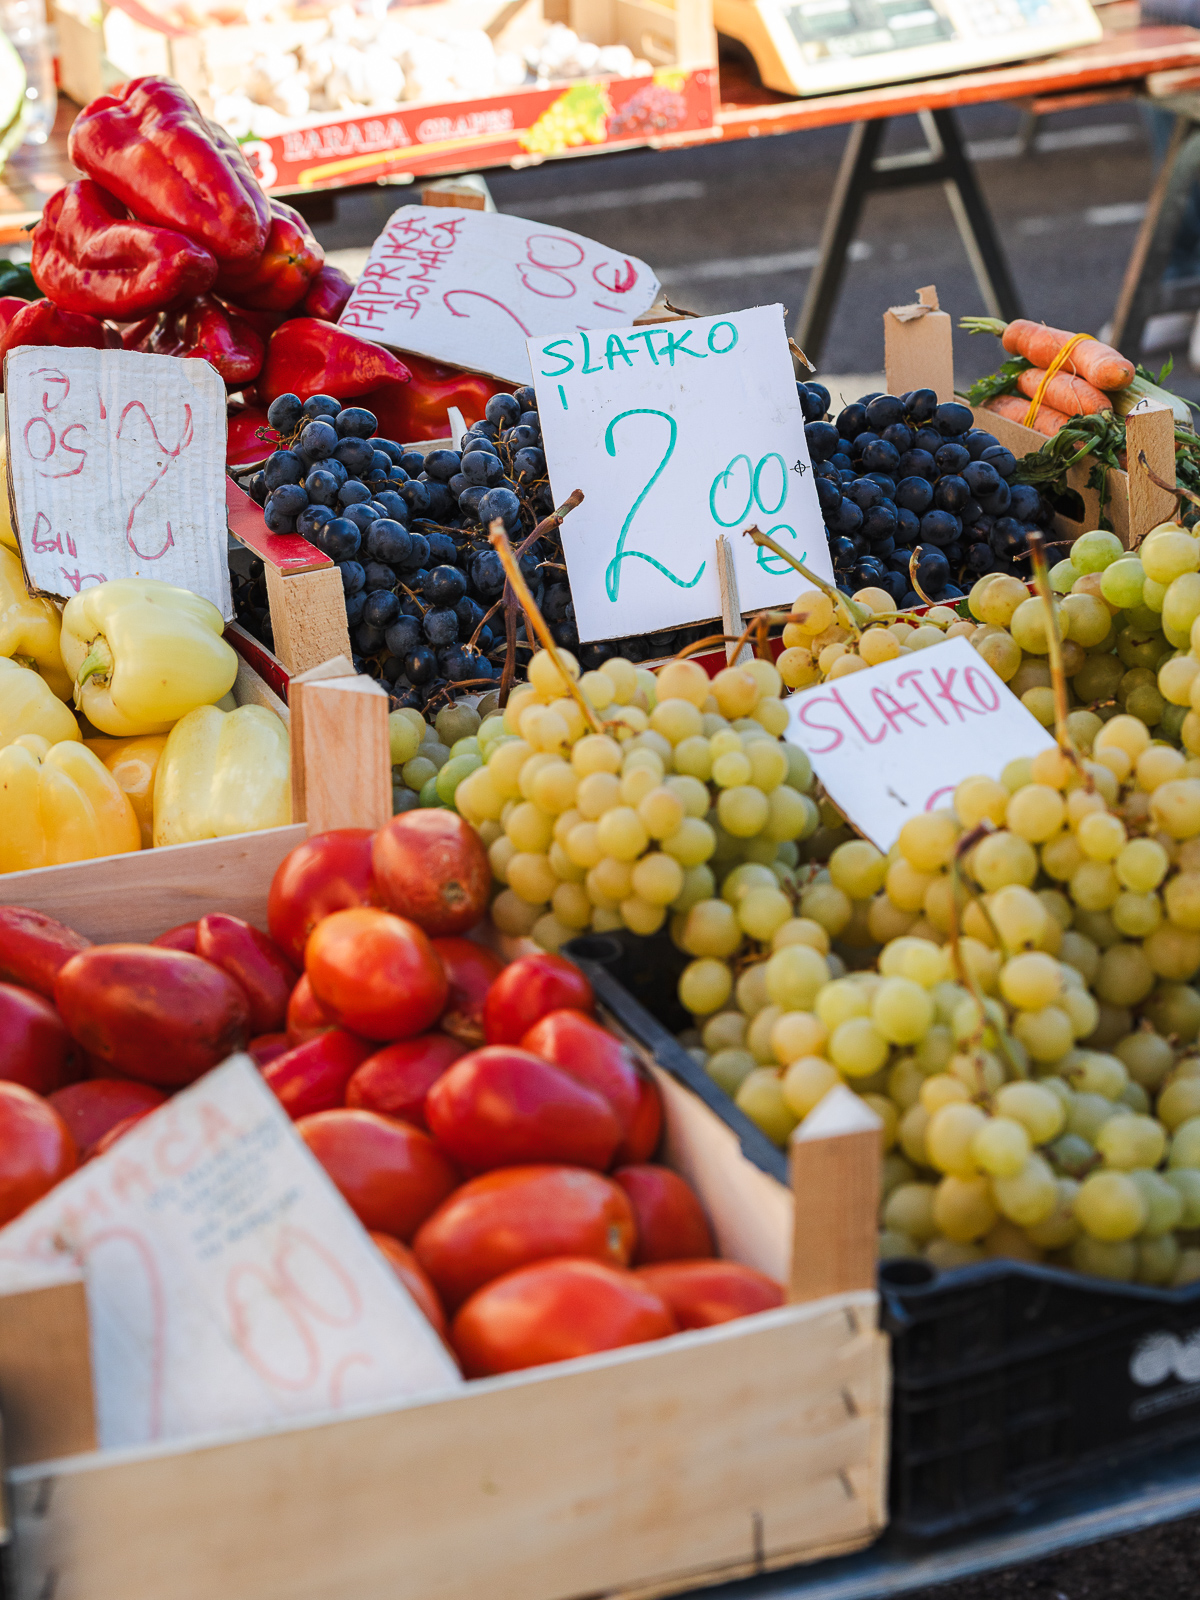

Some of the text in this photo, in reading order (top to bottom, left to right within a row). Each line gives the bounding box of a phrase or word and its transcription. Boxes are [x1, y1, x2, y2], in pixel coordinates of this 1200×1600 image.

[338, 216, 426, 331] PAPRIKA
[541, 321, 739, 376] SLATKO
[798, 665, 1001, 754] SLATKO
